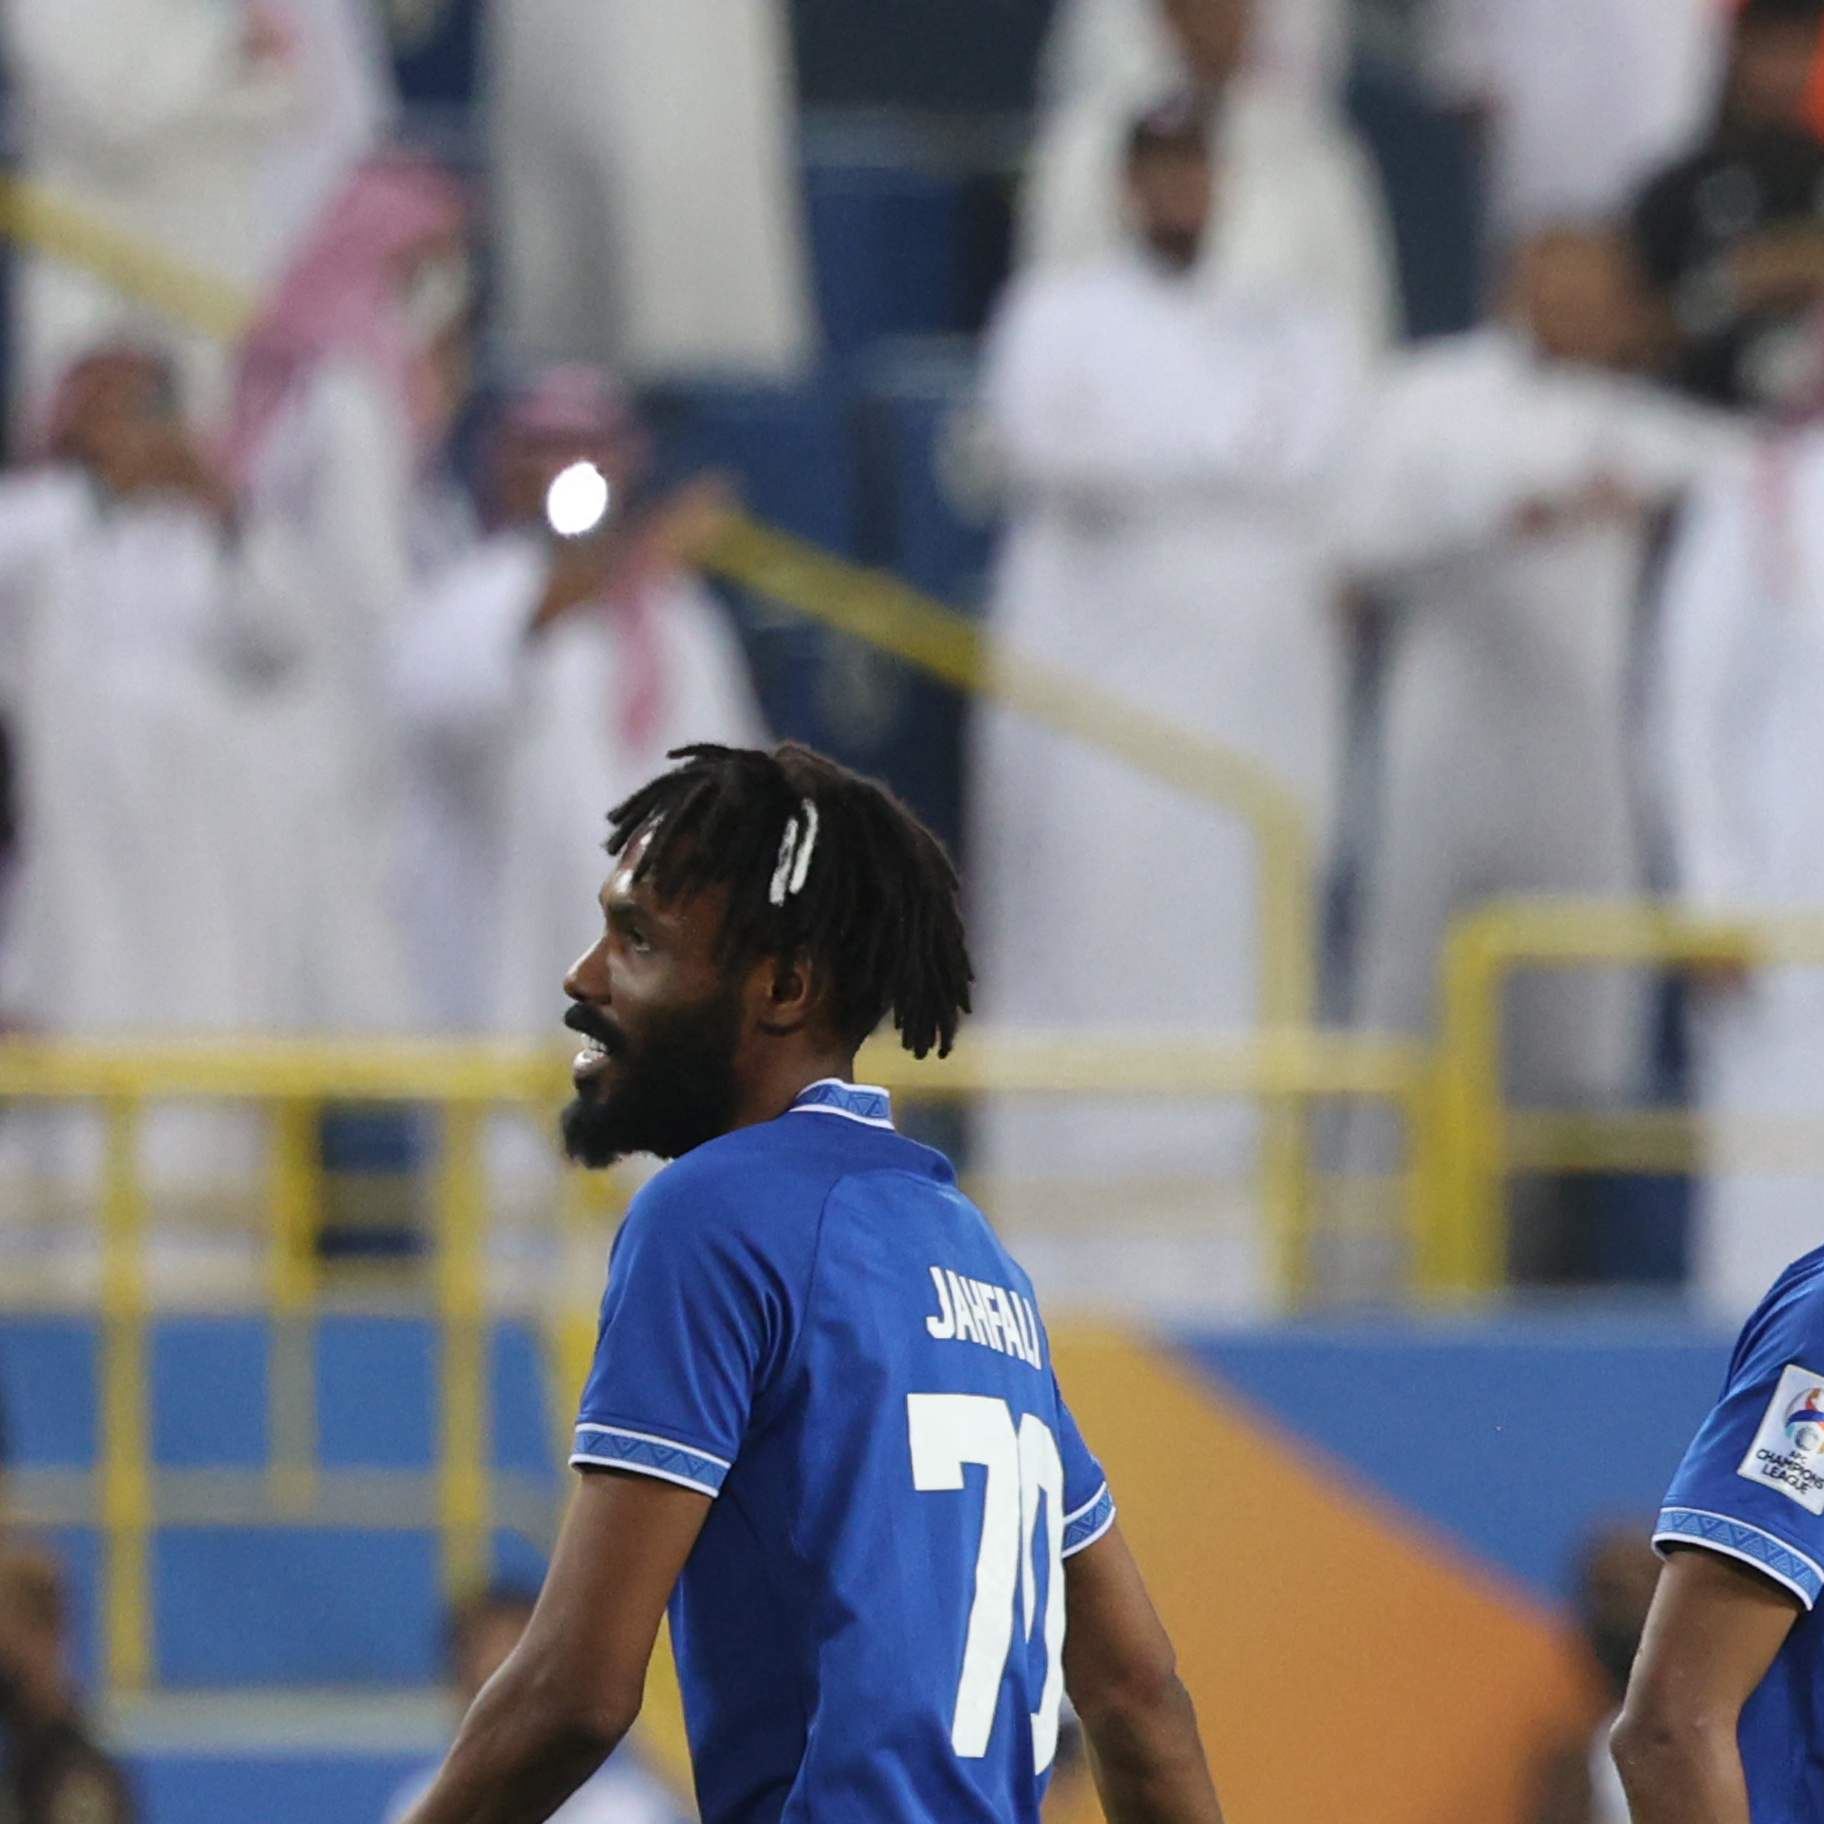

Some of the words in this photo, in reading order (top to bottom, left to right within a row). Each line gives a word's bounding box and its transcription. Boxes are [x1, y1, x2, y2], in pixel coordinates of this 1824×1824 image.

[1756, 1448, 1824, 1490] CHAMPIONS
[1761, 1464, 1811, 1495] LEAGUE
[907, 1393, 1066, 1776] 70
